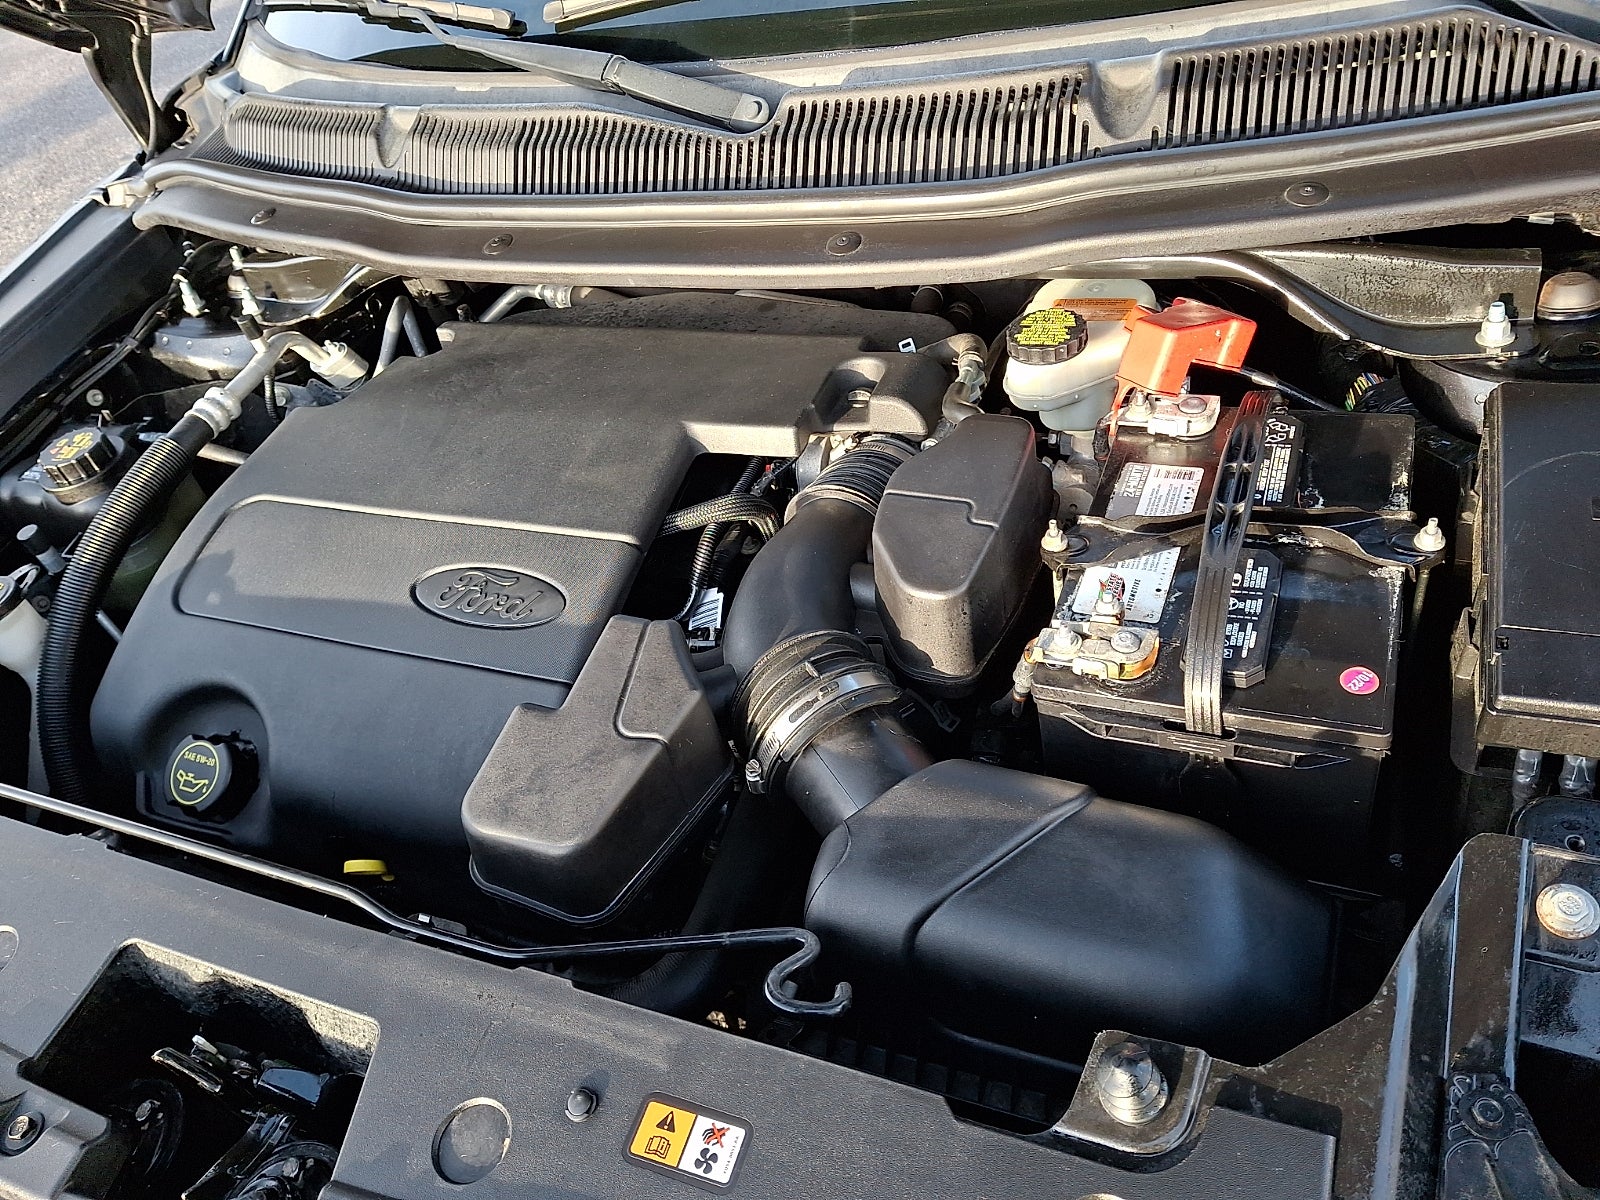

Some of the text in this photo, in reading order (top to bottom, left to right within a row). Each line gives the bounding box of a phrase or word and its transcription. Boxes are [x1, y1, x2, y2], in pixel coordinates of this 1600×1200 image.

[434, 570, 543, 621] Ford
[1126, 578, 1141, 611] AUTOMOTIVE
[1347, 671, 1374, 691] 10/22
[184, 751, 215, 767] SAE 5W-20
